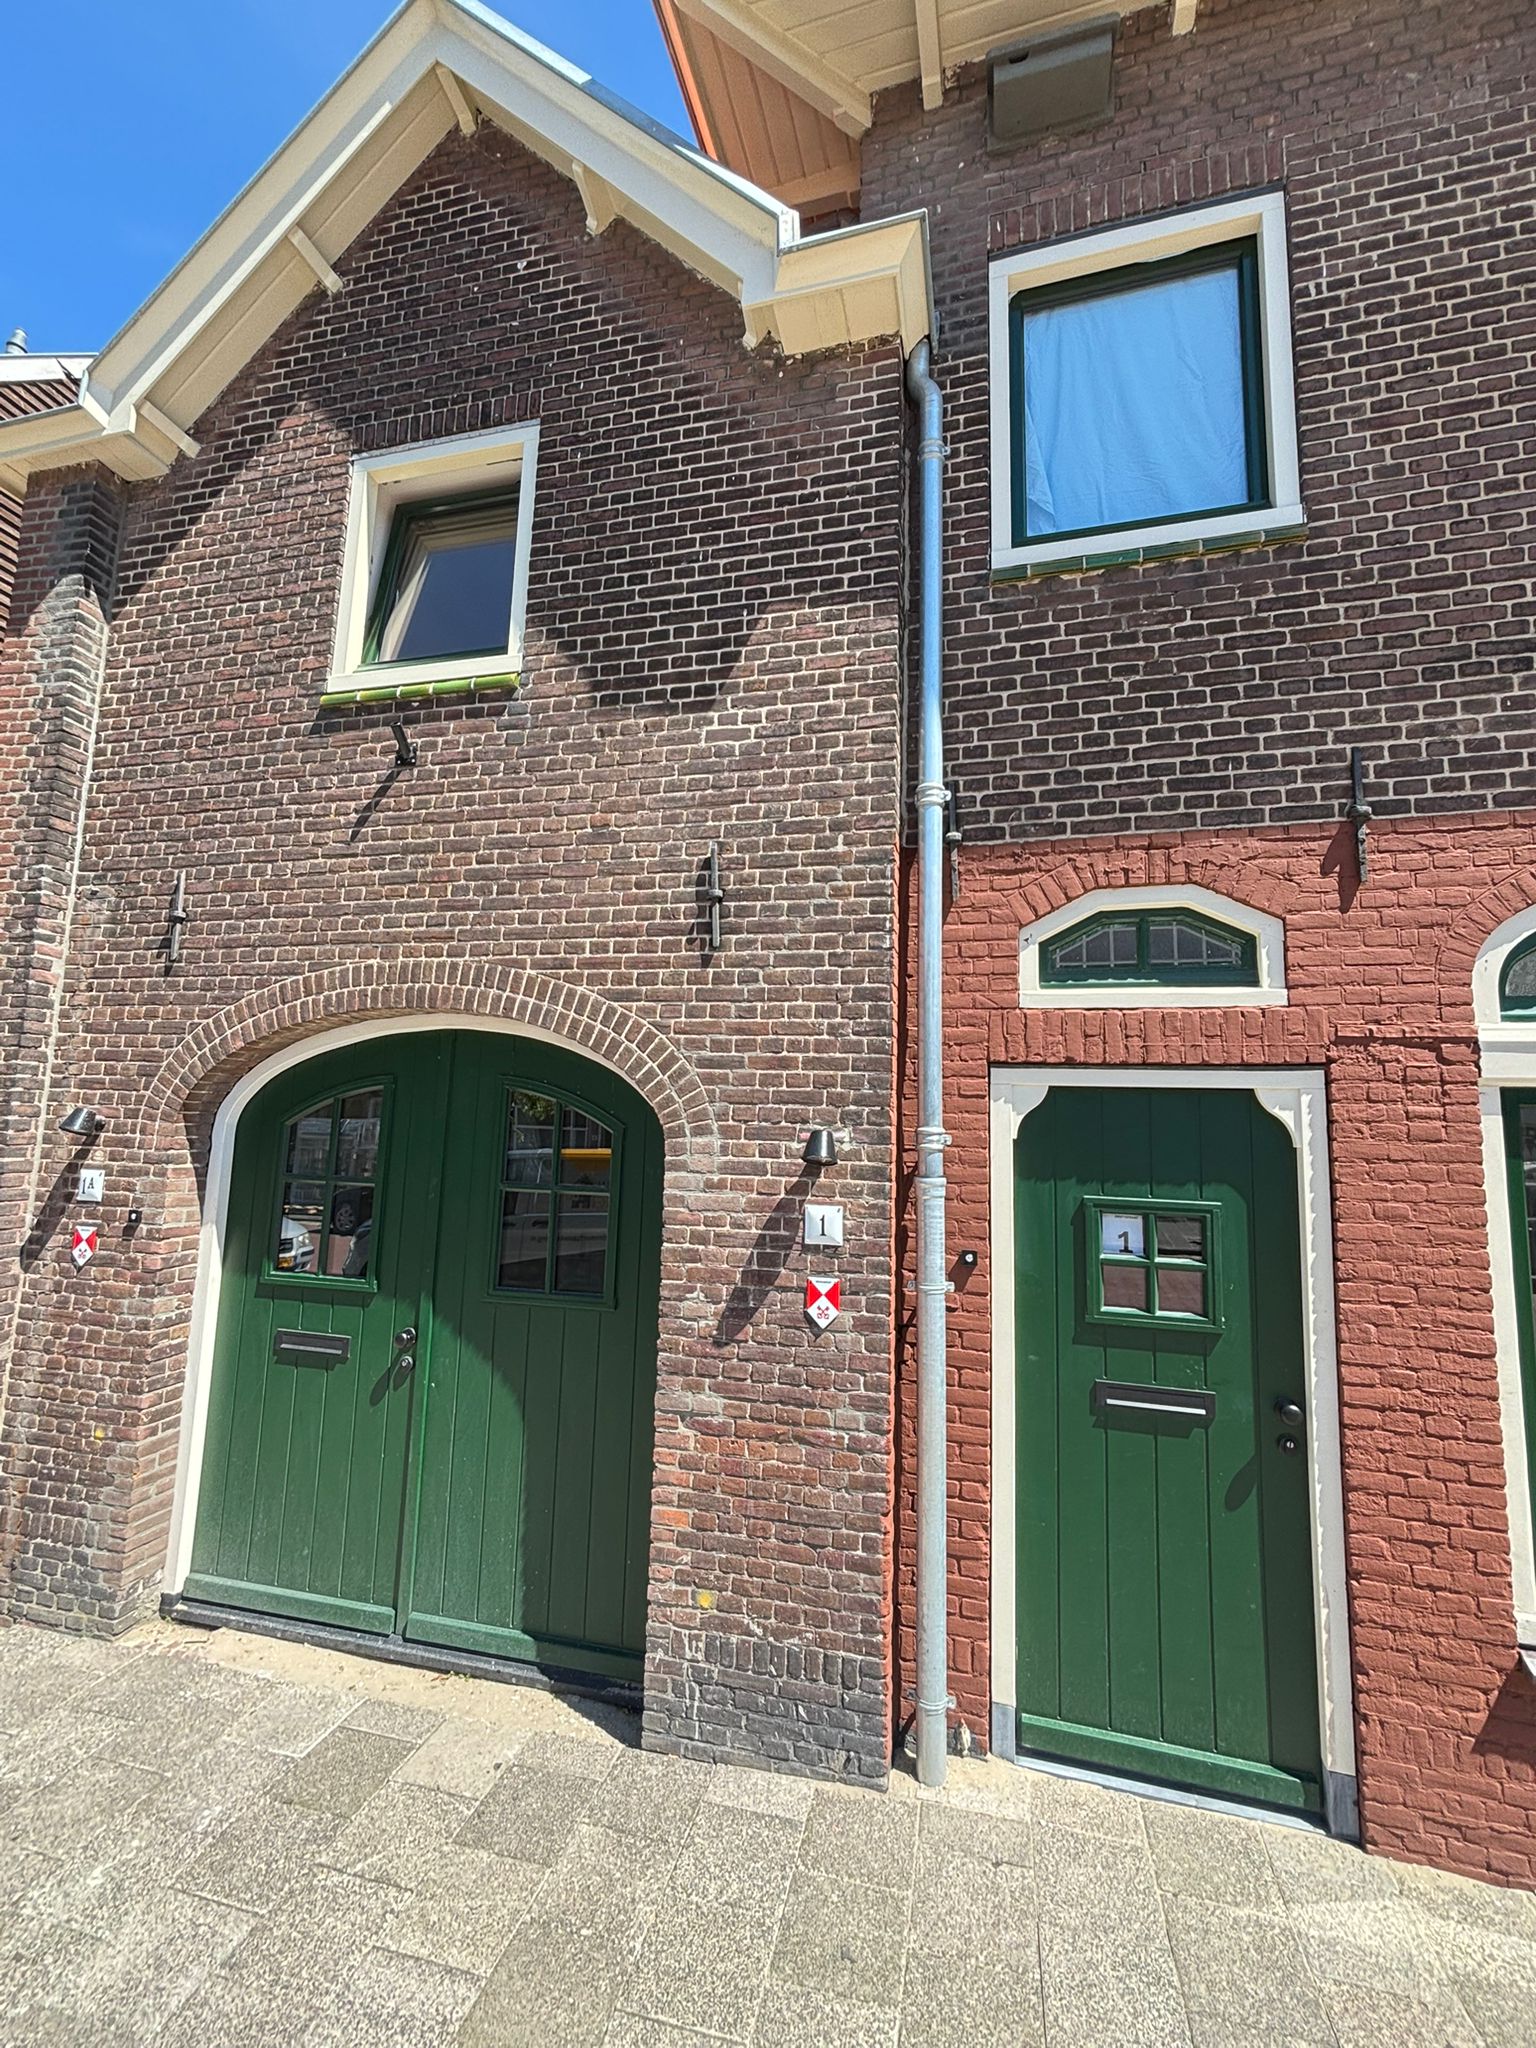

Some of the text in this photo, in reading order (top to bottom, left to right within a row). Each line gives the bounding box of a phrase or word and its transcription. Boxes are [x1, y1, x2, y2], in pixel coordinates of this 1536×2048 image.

[81, 1176, 95, 1195] 1A
[819, 1214, 828, 1237] 1
[1117, 1231, 1134, 1254] 1
